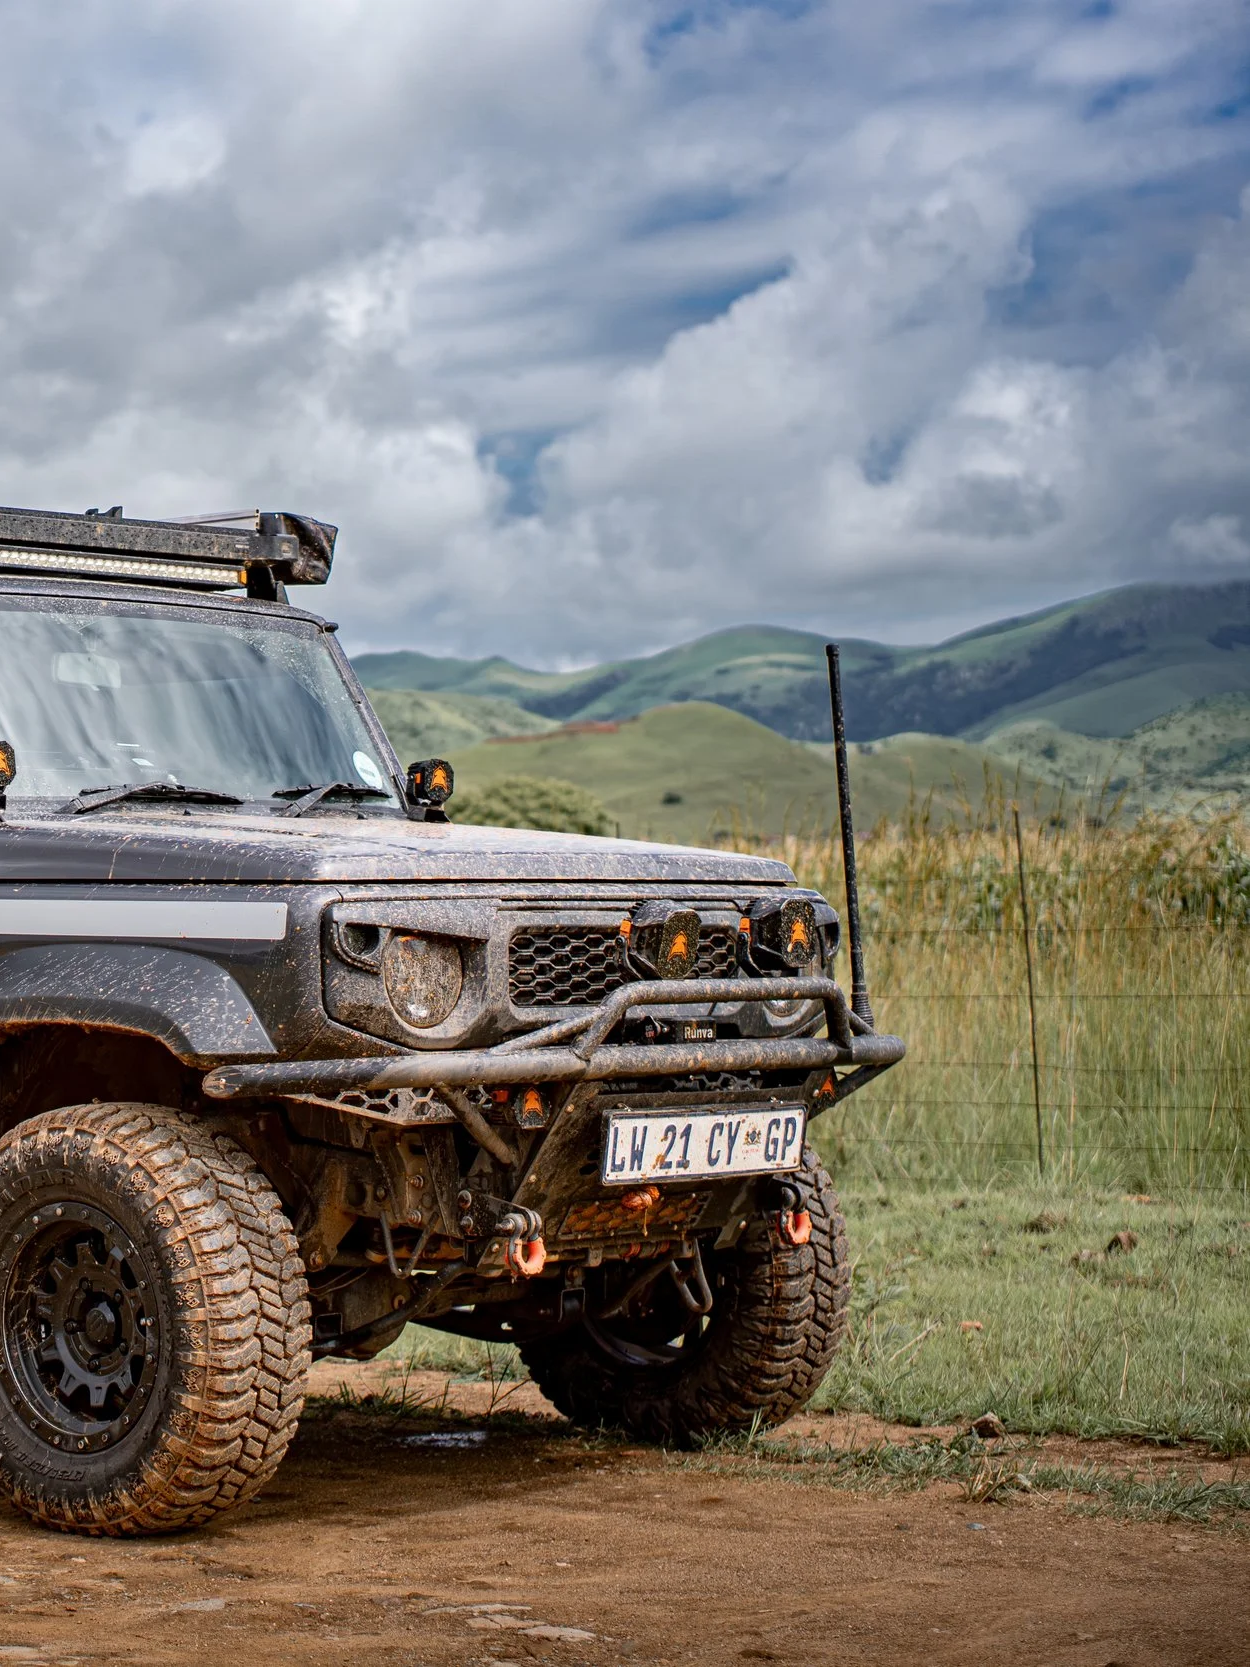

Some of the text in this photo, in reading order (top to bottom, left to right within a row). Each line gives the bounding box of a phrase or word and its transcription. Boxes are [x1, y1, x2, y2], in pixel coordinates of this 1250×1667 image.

[684, 1026, 713, 1039] Runva
[610, 1117, 797, 1173] LW 21 CY GP
